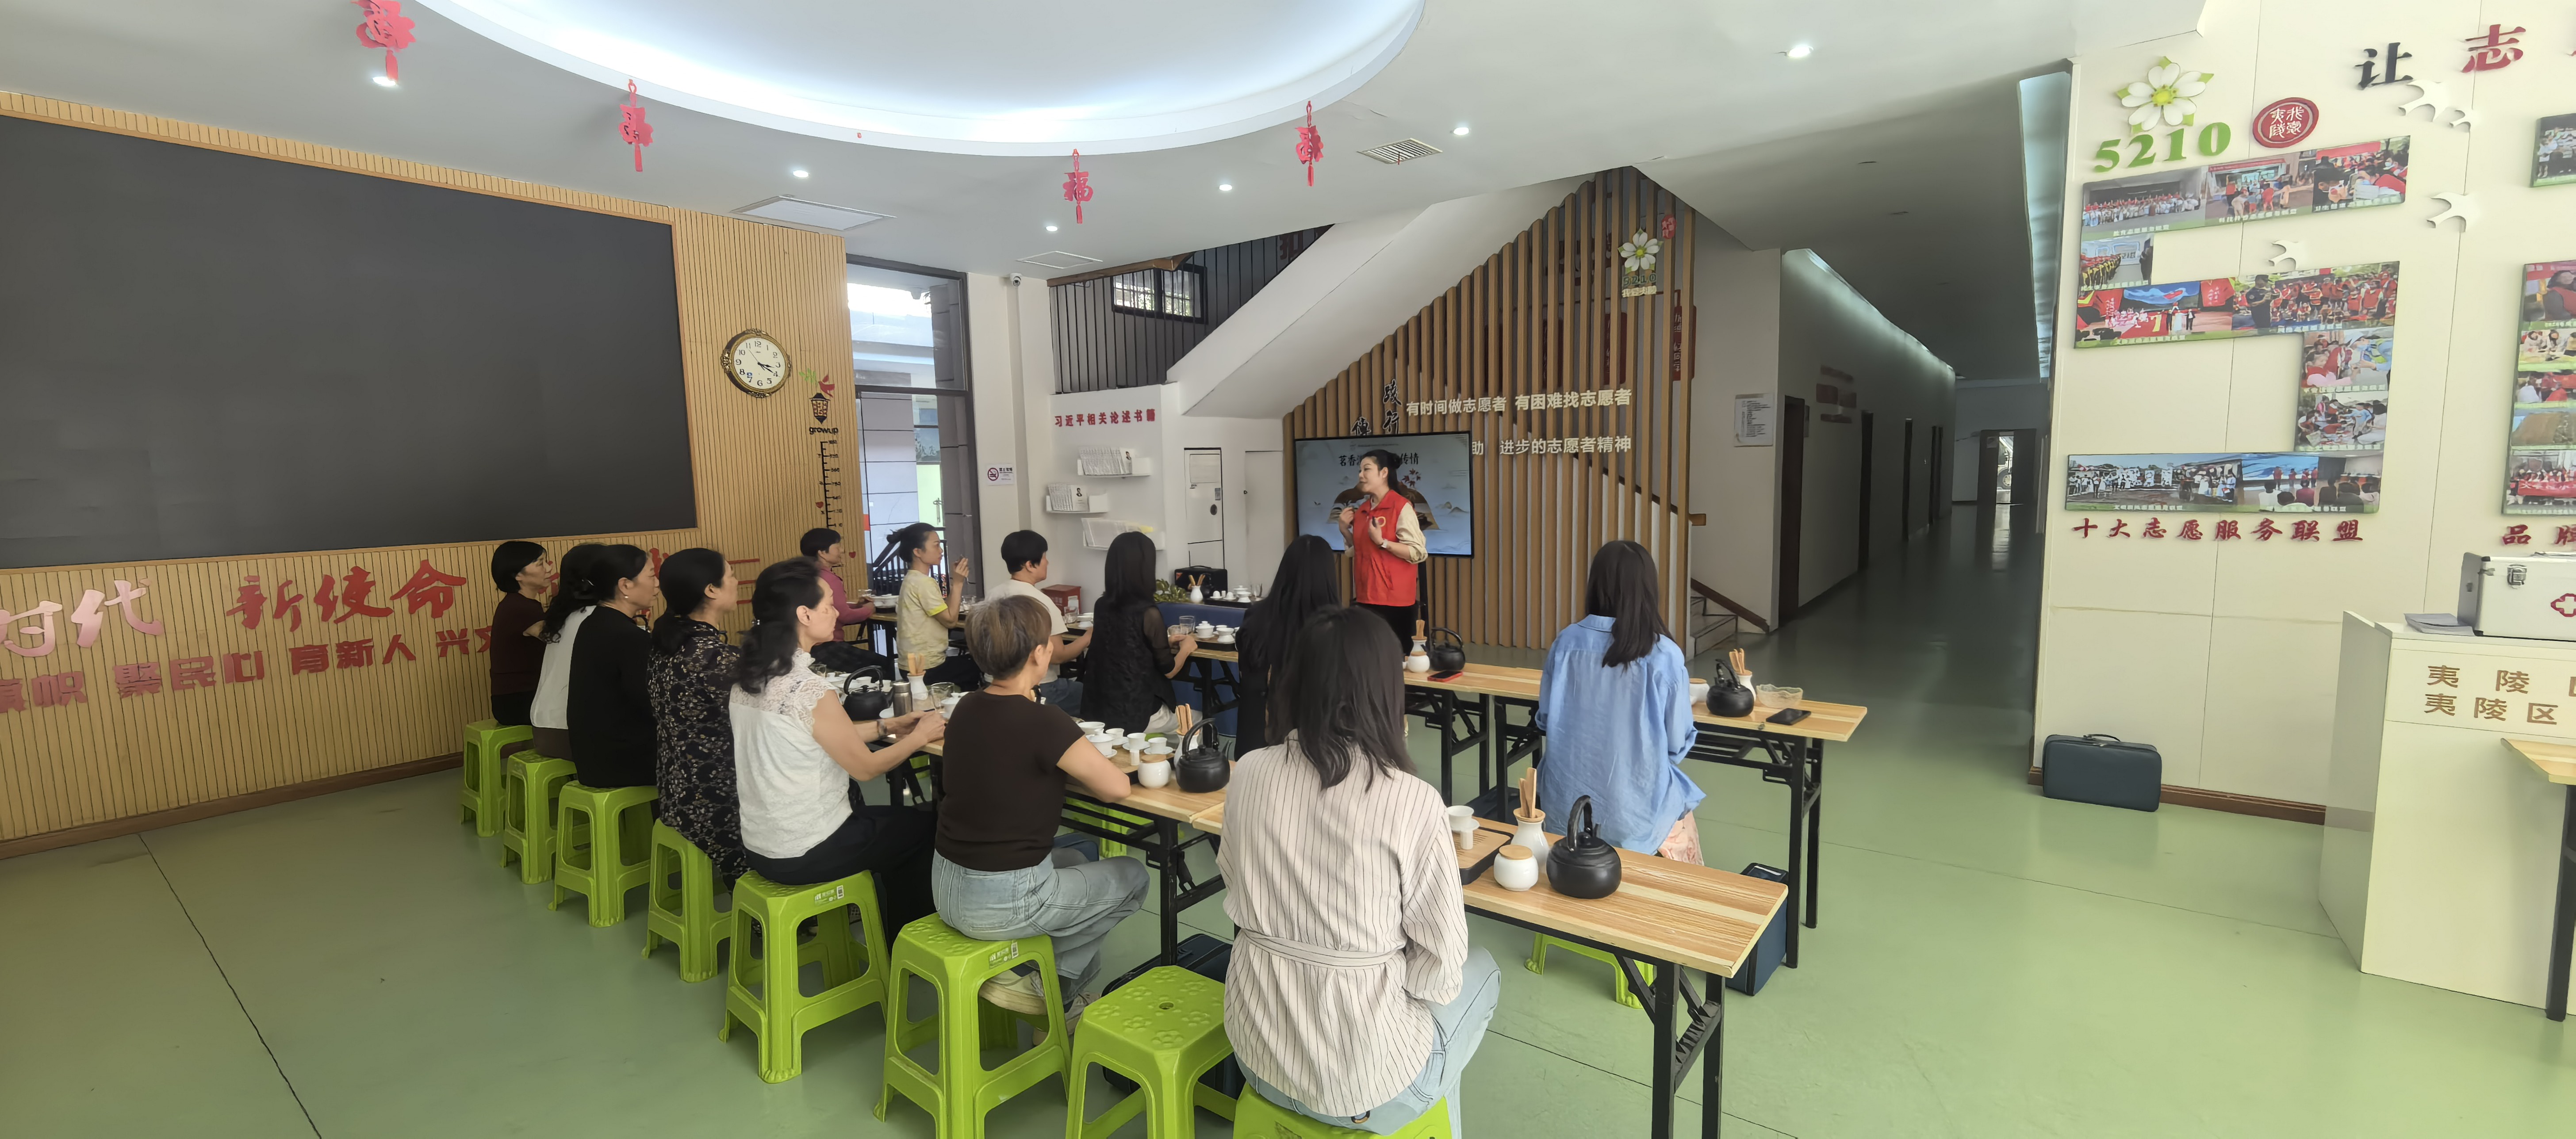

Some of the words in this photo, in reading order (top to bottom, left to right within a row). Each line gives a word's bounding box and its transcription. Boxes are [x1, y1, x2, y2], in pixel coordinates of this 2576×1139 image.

[2094, 122, 2231, 172] 5210
[1623, 273, 1656, 287] 5210
[1407, 396, 1506, 416] 有时间做志愿者
[1515, 388, 1632, 410] 有困难找志愿者
[1500, 436, 1632, 455] 进步的志愿者精神
[2072, 517, 2363, 541] 十大志愿服务联盟
[226, 559, 466, 632] 新使命
[113, 650, 265, 699] 聚民心
[289, 634, 416, 675] 育新人
[2427, 665, 2576, 697] 夷陵
[2424, 693, 2558, 725] 夷陵区
